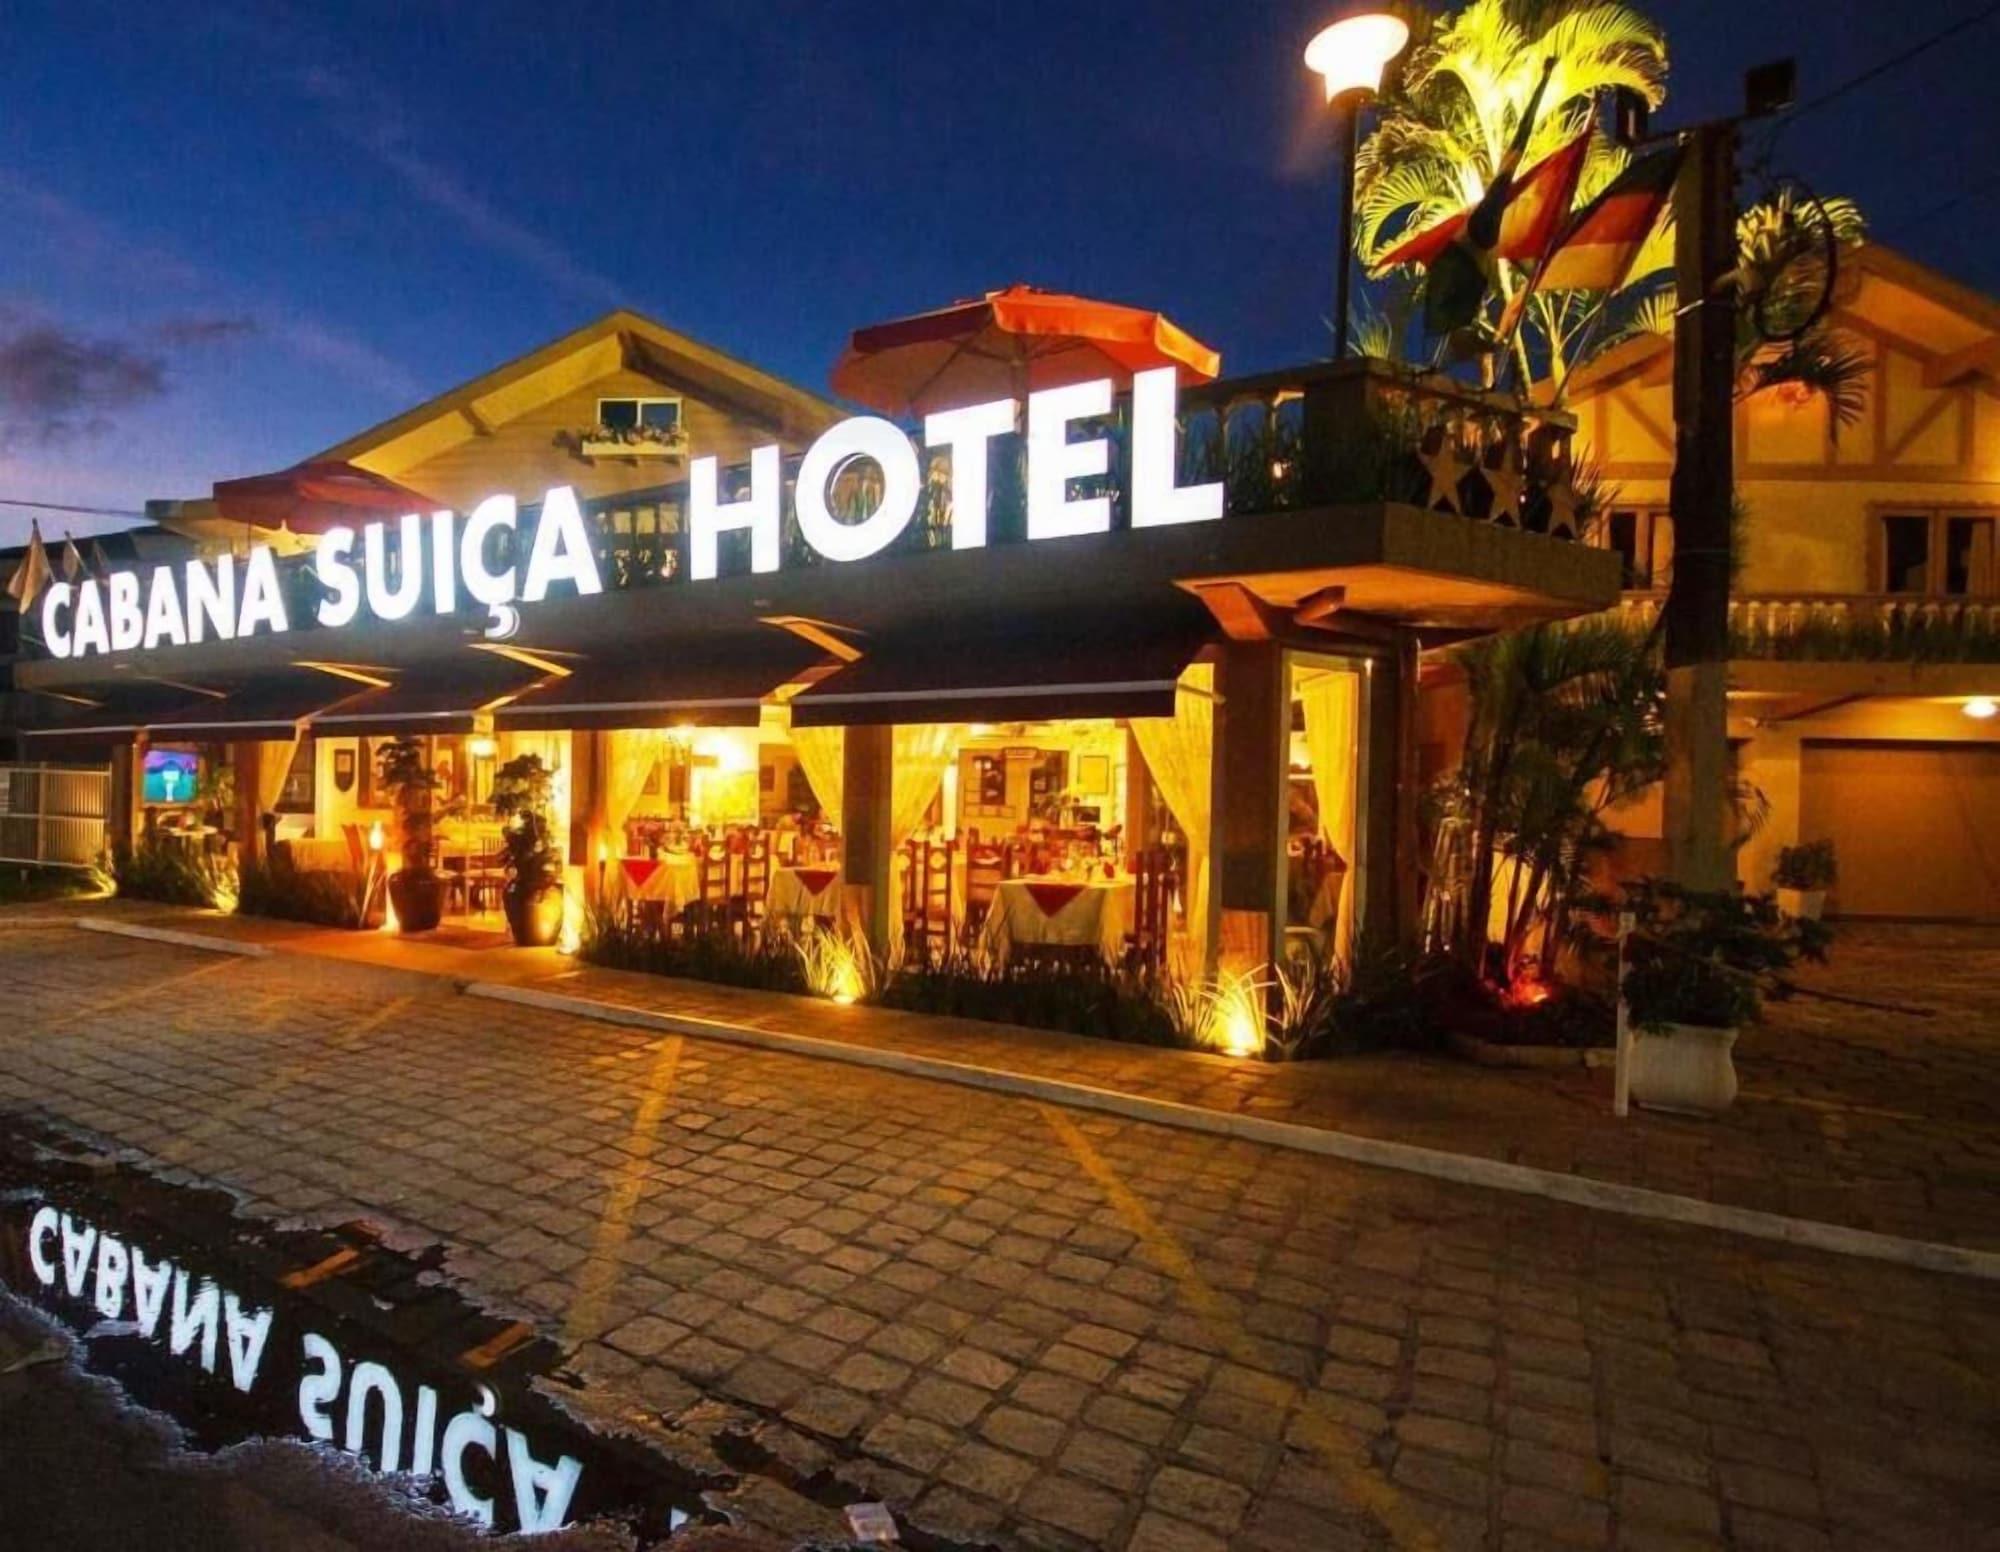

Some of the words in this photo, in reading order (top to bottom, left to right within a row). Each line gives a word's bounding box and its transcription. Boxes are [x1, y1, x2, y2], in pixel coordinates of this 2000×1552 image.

[42, 543, 289, 659] CABANA
[314, 484, 603, 640] SUIÇA
[687, 367, 1224, 581] HOTEL
